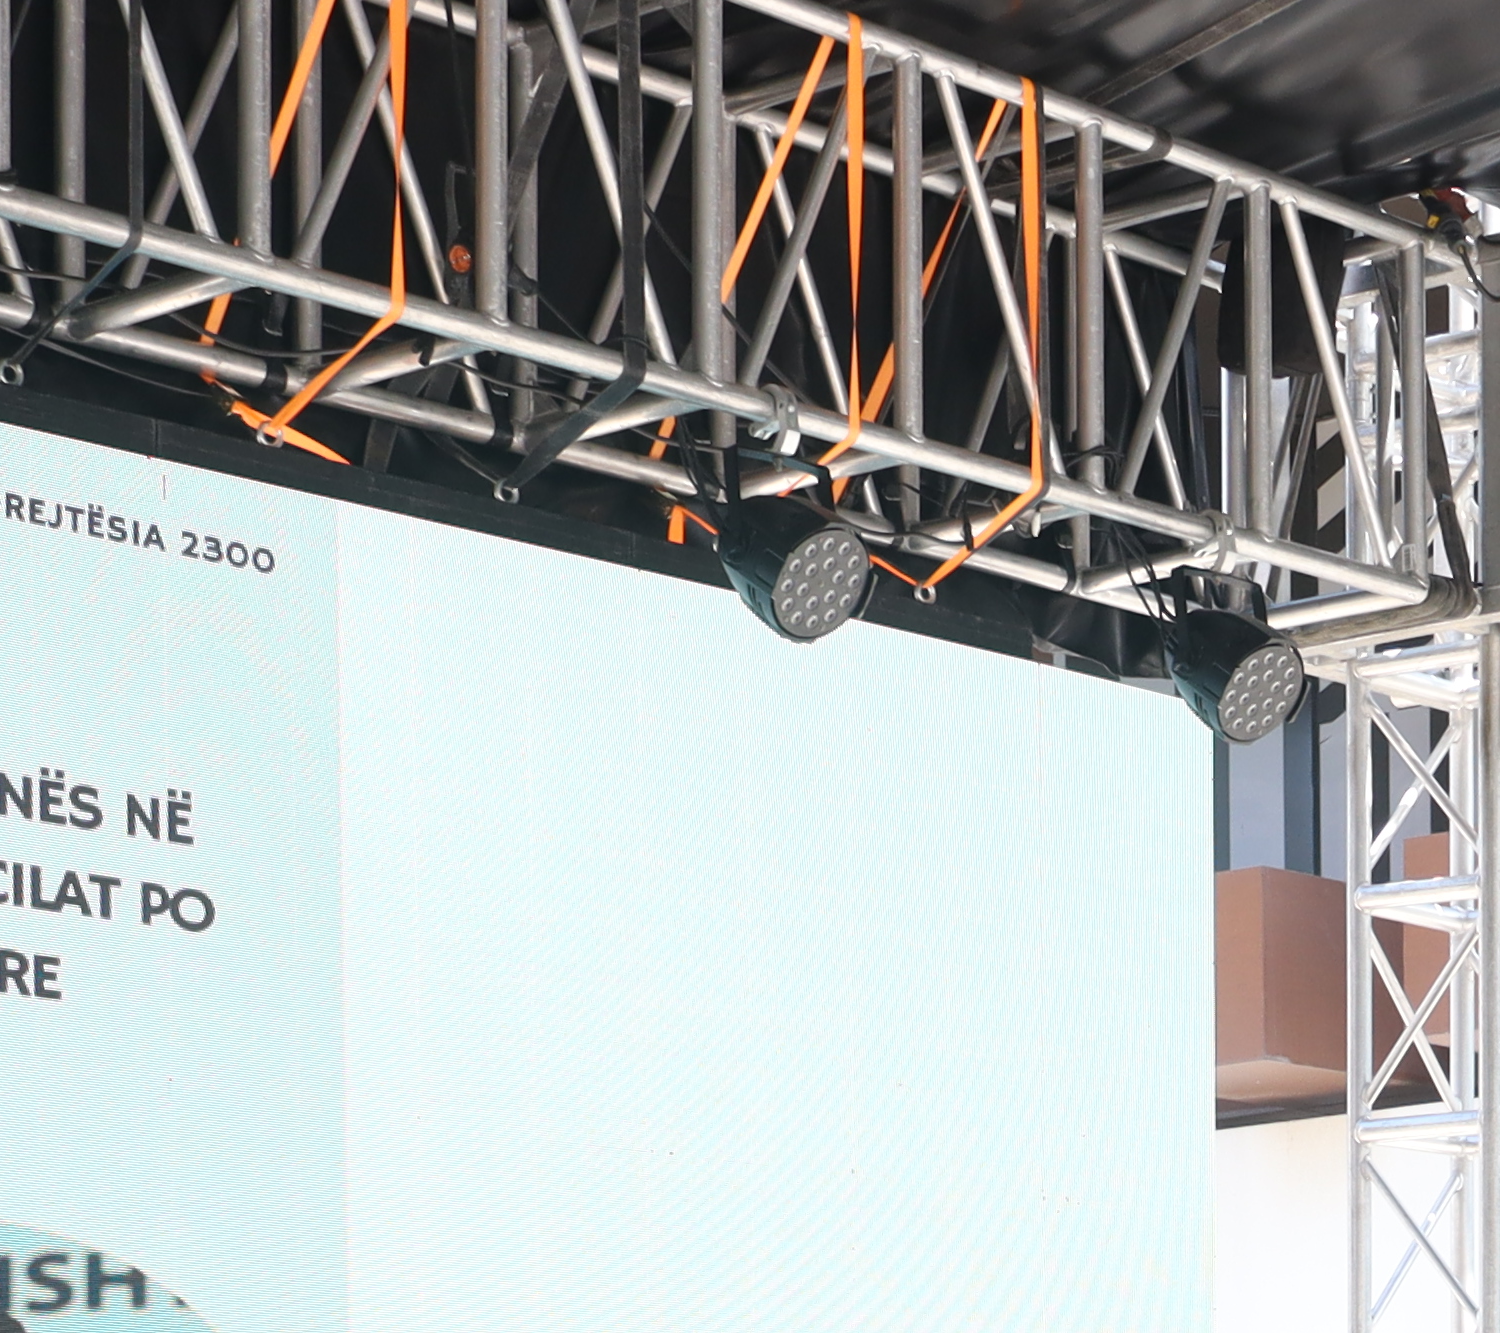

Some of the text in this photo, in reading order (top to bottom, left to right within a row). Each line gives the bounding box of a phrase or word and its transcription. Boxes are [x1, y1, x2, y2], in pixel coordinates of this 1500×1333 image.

[181, 531, 276, 574] 2300
[126, 789, 195, 846] NË
[140, 882, 217, 932] PO
